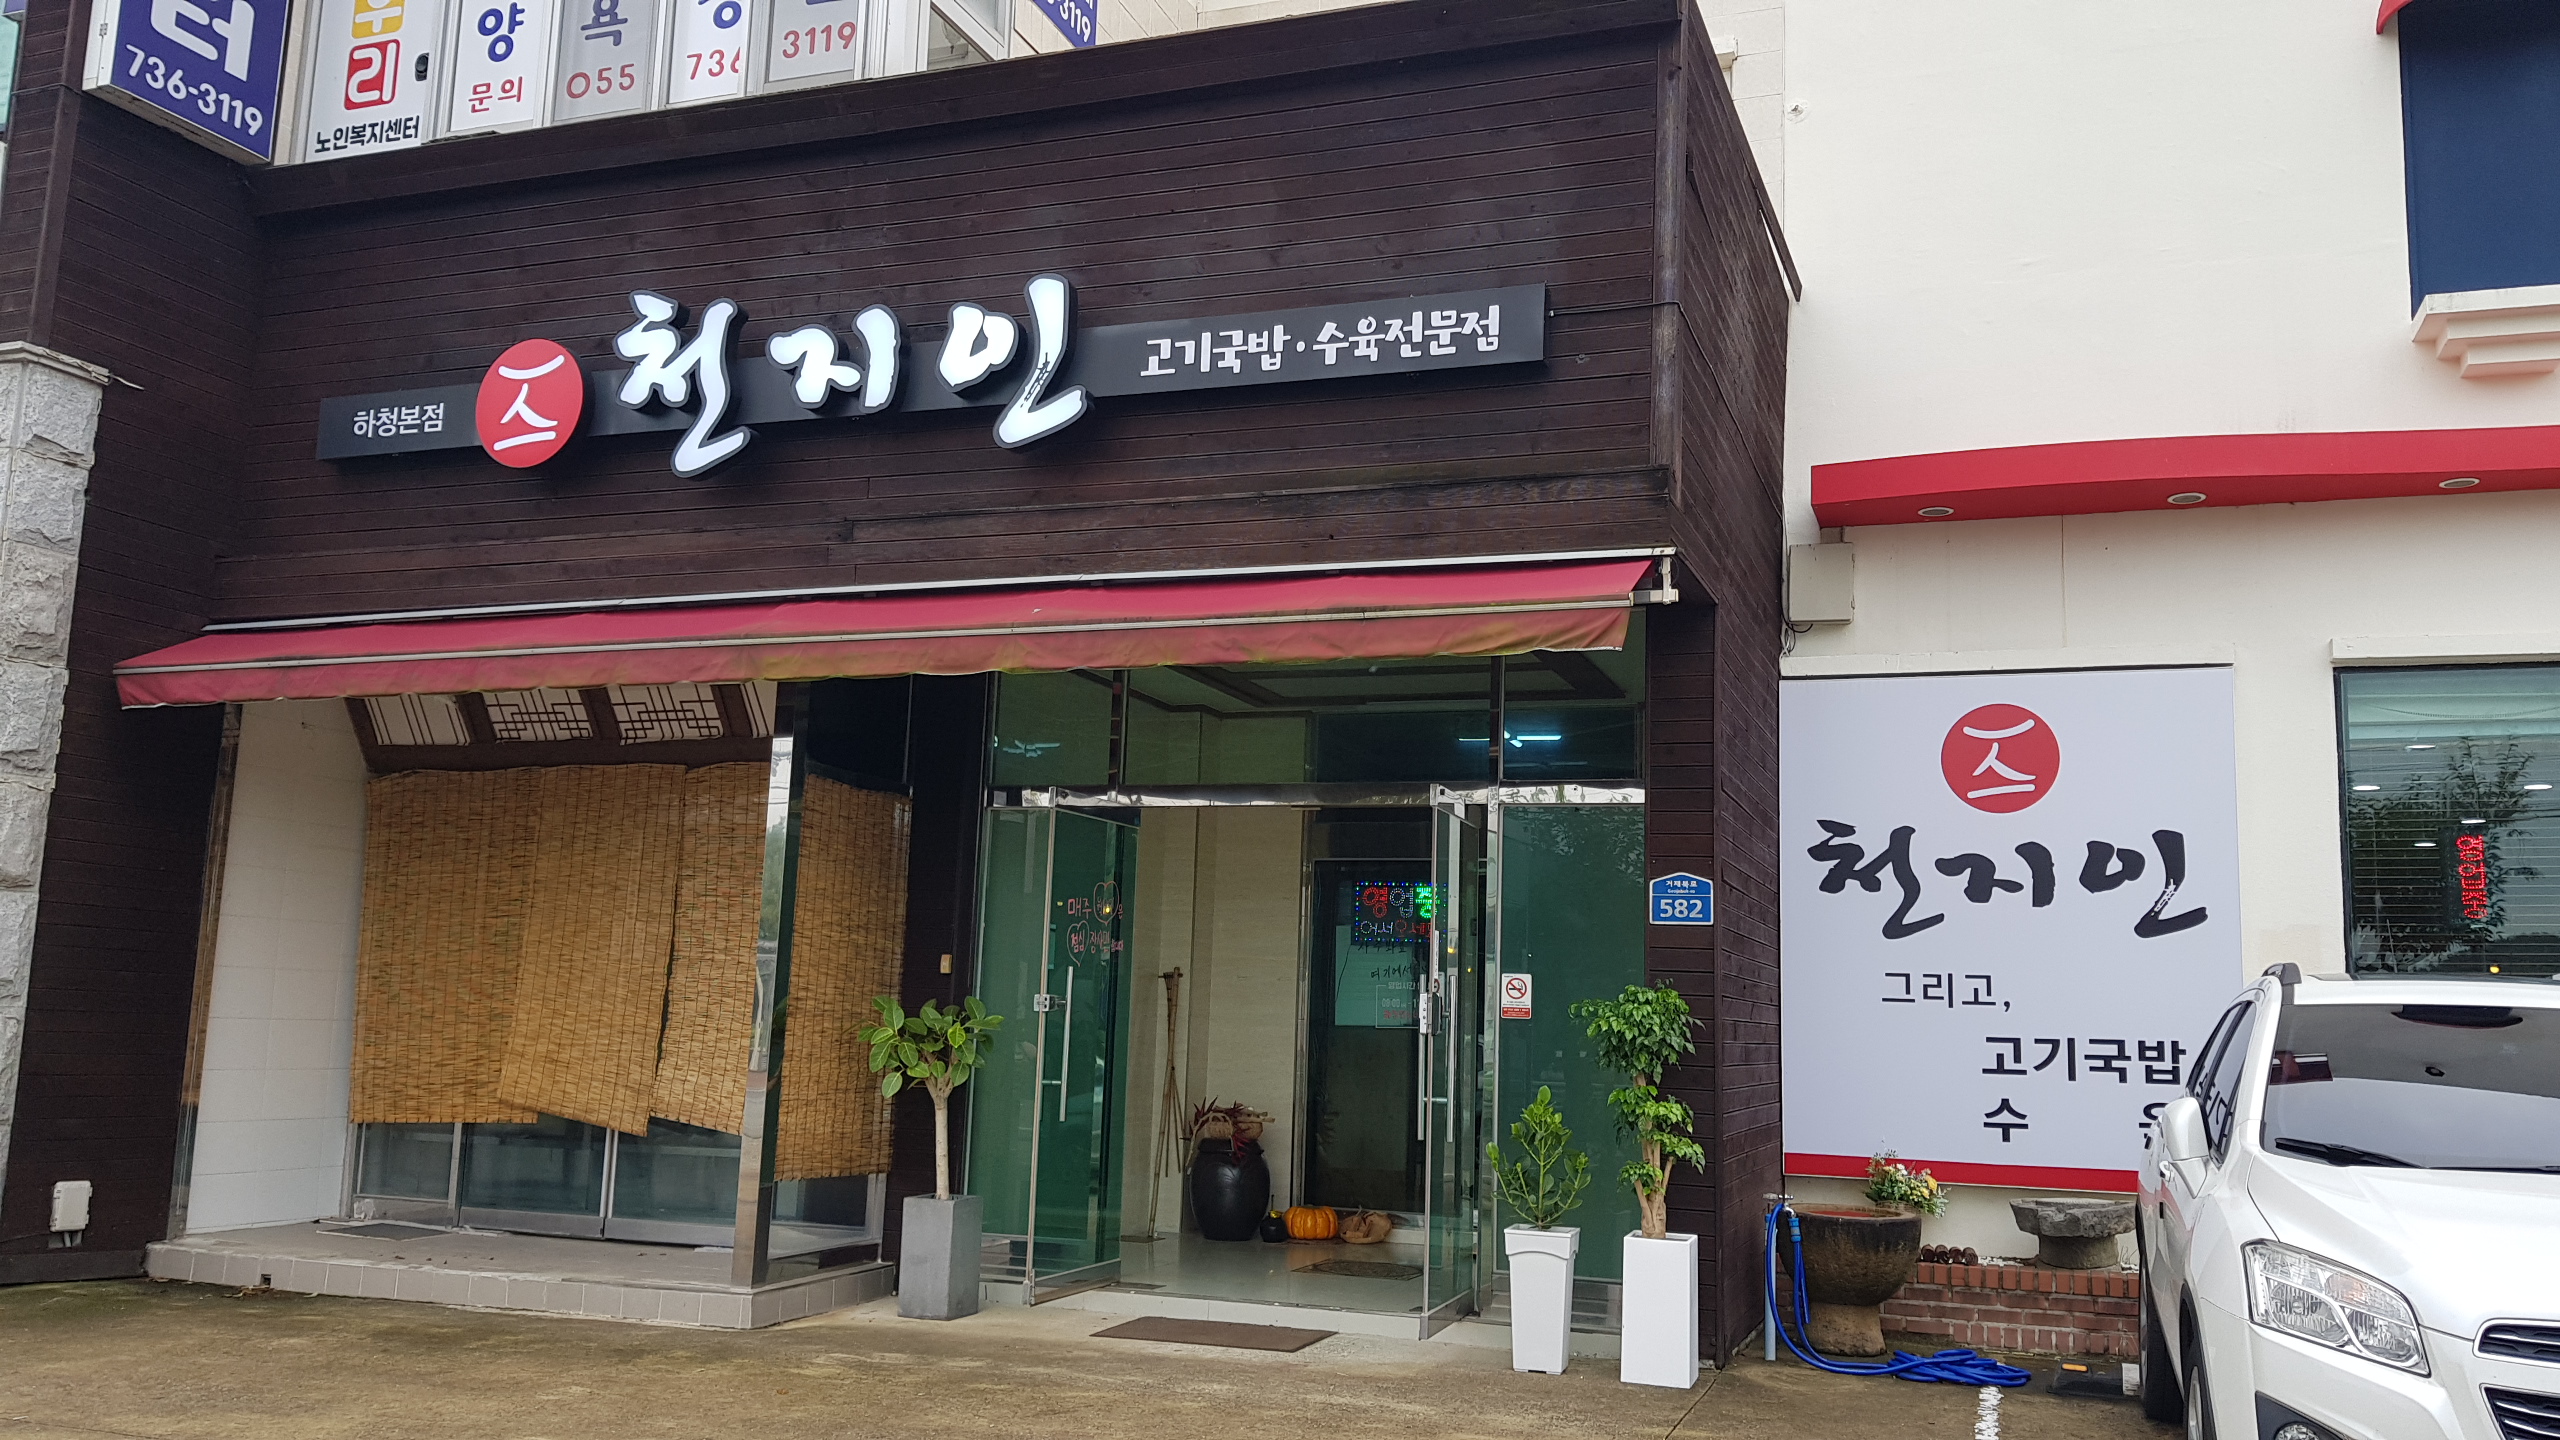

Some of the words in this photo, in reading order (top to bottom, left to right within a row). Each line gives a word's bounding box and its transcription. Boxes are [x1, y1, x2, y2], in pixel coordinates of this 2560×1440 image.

[477, 2, 526, 63] 양
[126, 44, 264, 137] 736-3119
[468, 76, 523, 113] 문의
[566, 63, 635, 99] 055
[782, 21, 856, 59] 3119
[314, 116, 421, 154] 노인복지센터
[352, 402, 446, 438] 하청본점
[613, 274, 1089, 475] 천지인
[1362, 886, 1440, 919] 영업중
[1665, 880, 1698, 888] 거제북로
[1807, 819, 2208, 940] 천지인
[2456, 834, 2488, 920] 영업중
[1068, 898, 1092, 920] 매주
[1660, 899, 1703, 918] 582
[1881, 972, 2012, 1013] 그리고,
[1982, 1034, 2187, 1086] 고기국밥
